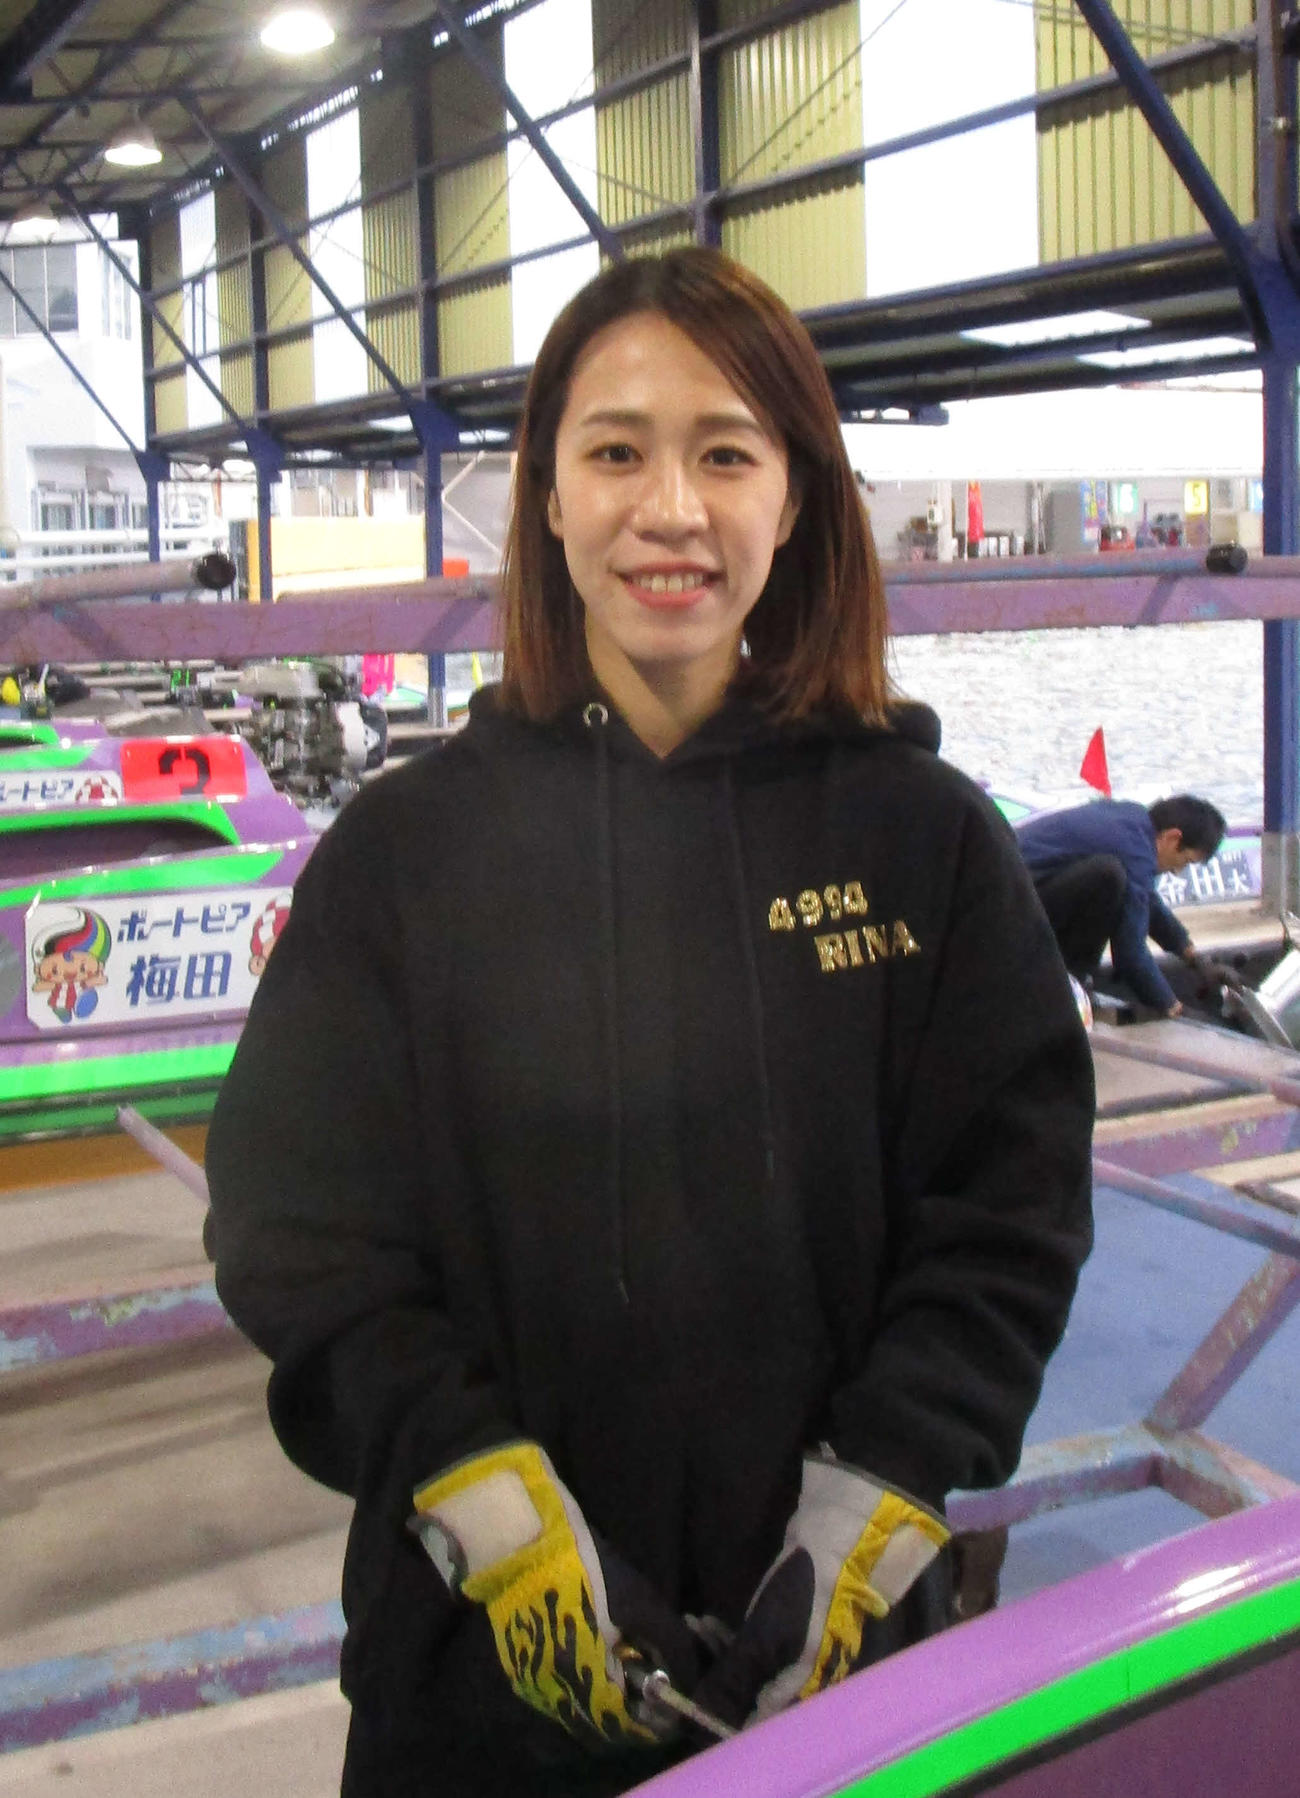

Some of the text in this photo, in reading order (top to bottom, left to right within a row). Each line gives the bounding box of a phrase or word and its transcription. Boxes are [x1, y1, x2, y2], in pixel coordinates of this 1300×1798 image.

[116, 902, 252, 943] ボートピア
[768, 880, 869, 931] 4994
[814, 919, 922, 973] RINA
[126, 951, 232, 1007] 梅田
